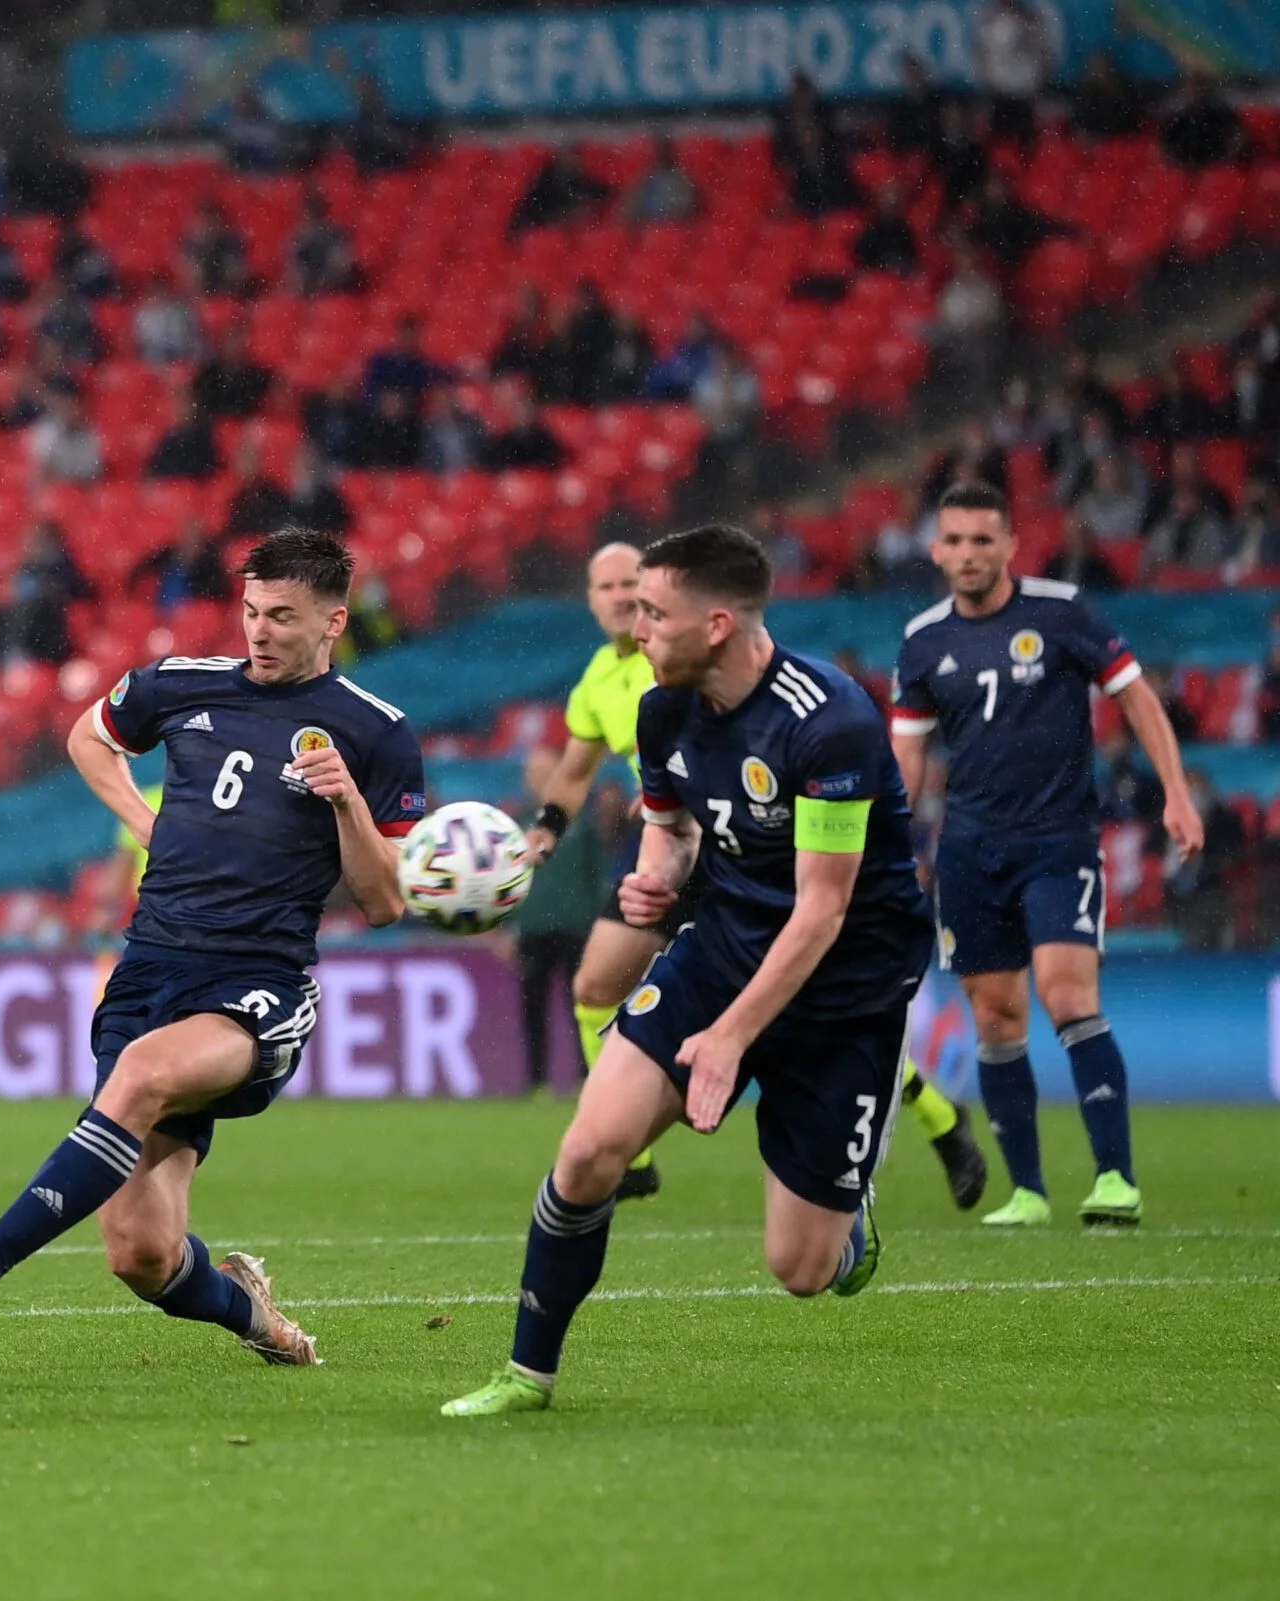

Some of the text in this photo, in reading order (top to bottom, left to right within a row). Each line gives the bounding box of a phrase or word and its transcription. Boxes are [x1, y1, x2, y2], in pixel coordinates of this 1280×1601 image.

[425, 22, 628, 106] UEFA
[637, 10, 853, 96] EURO
[976, 668, 999, 722] 7
[212, 750, 254, 809] 6
[707, 798, 743, 856] 3
[1077, 866, 1096, 915] 7
[239, 988, 280, 1019] 6
[846, 1093, 877, 1163] 3
